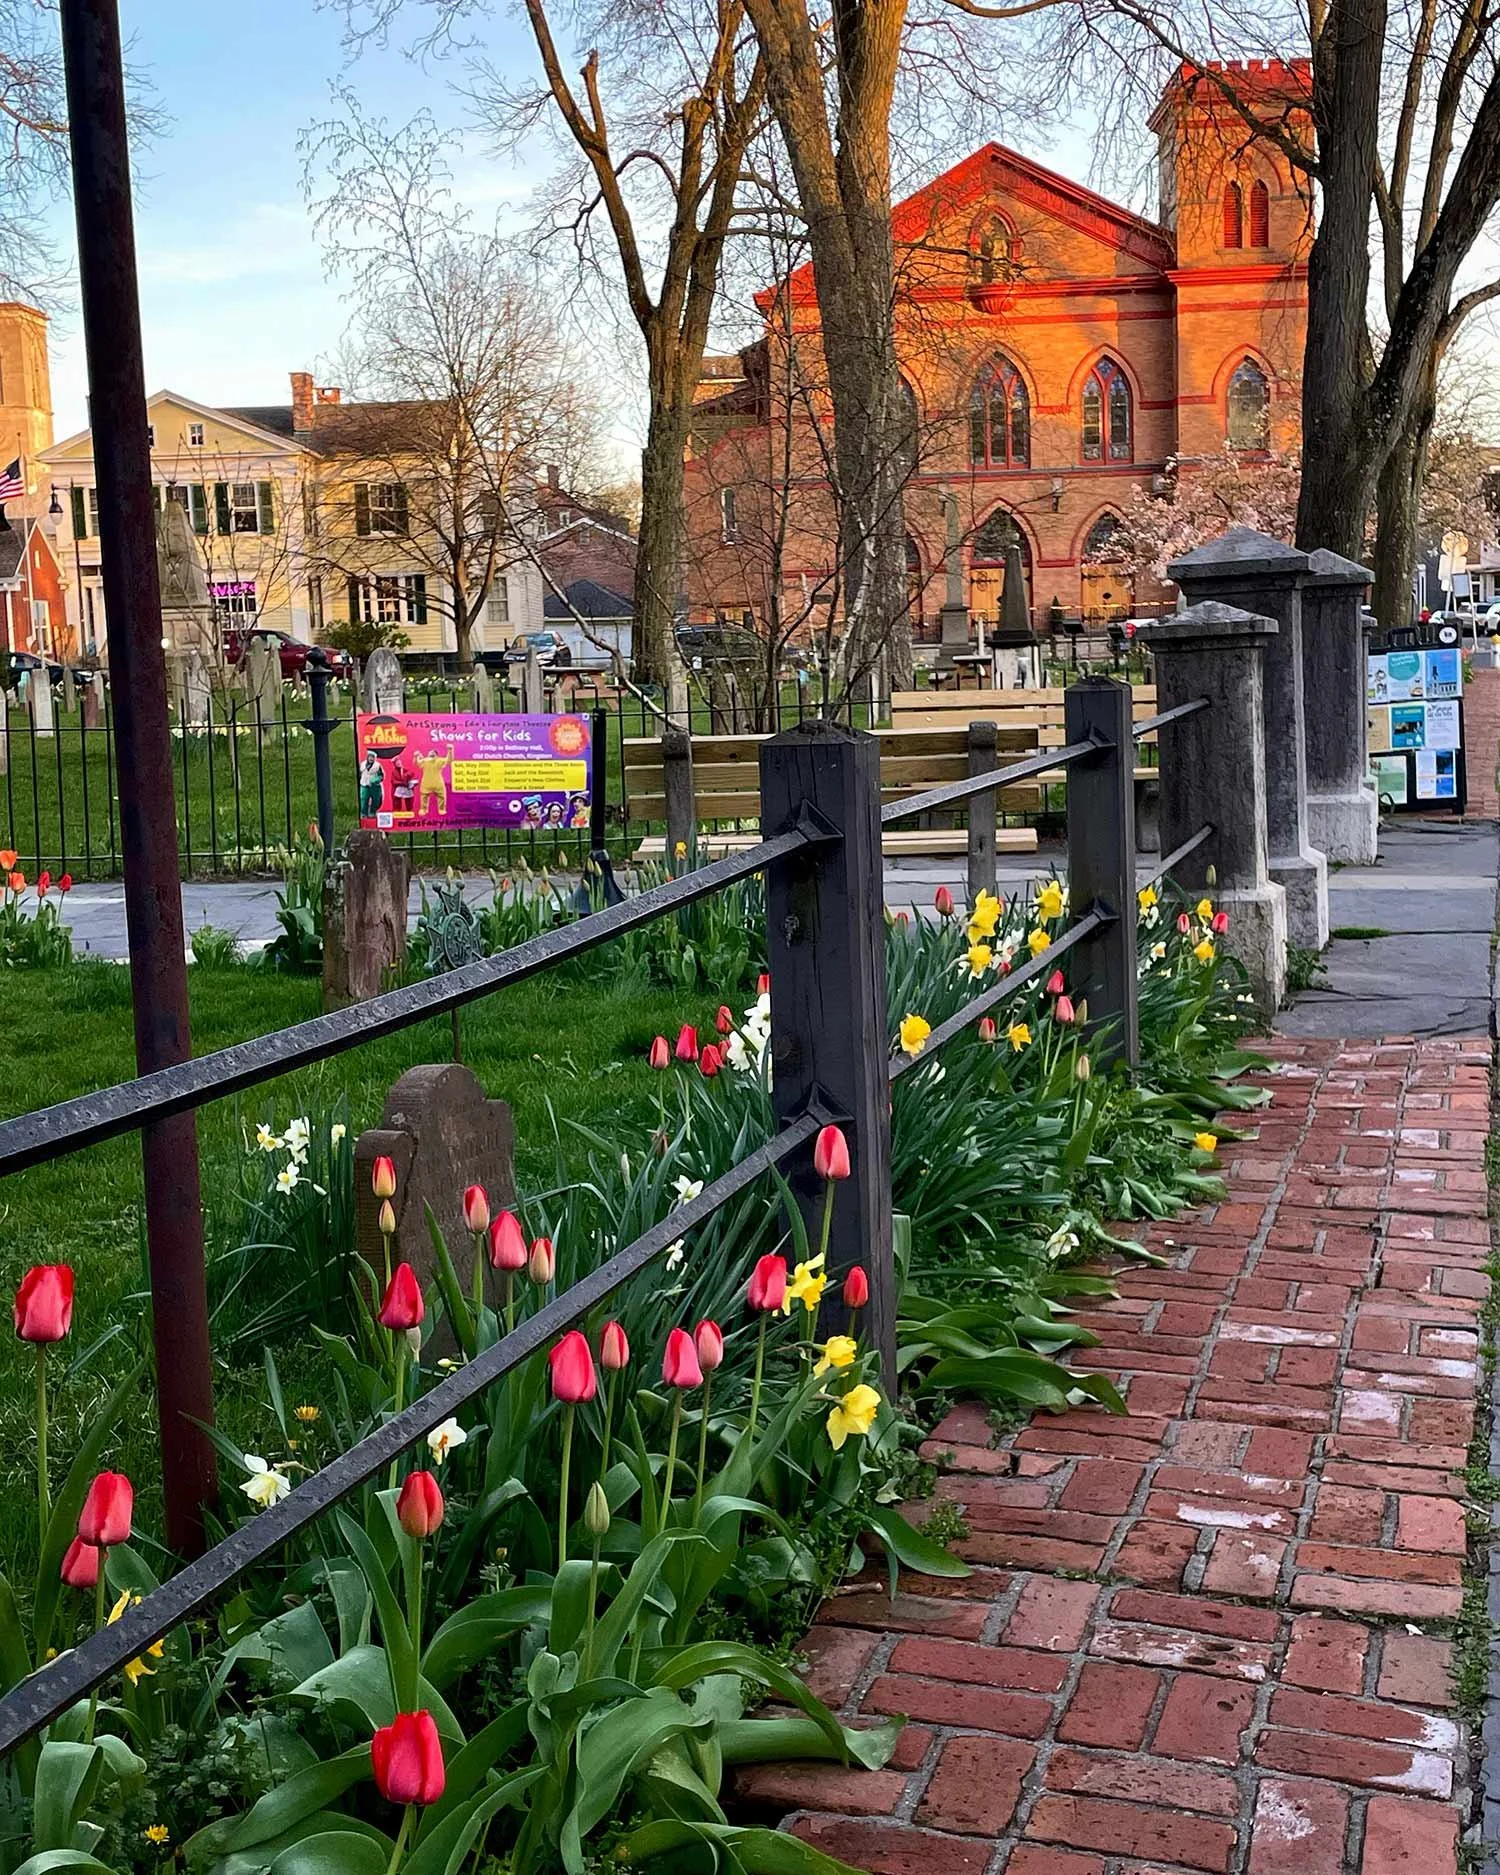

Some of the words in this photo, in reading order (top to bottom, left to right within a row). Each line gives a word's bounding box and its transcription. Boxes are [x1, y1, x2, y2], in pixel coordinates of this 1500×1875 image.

[406, 719, 456, 730] ArtStrong
[374, 726, 397, 736] Art
[430, 729, 473, 742] Shows
[477, 730, 498, 741] for
[502, 729, 531, 741] Kids
[364, 735, 407, 744] STRONG
